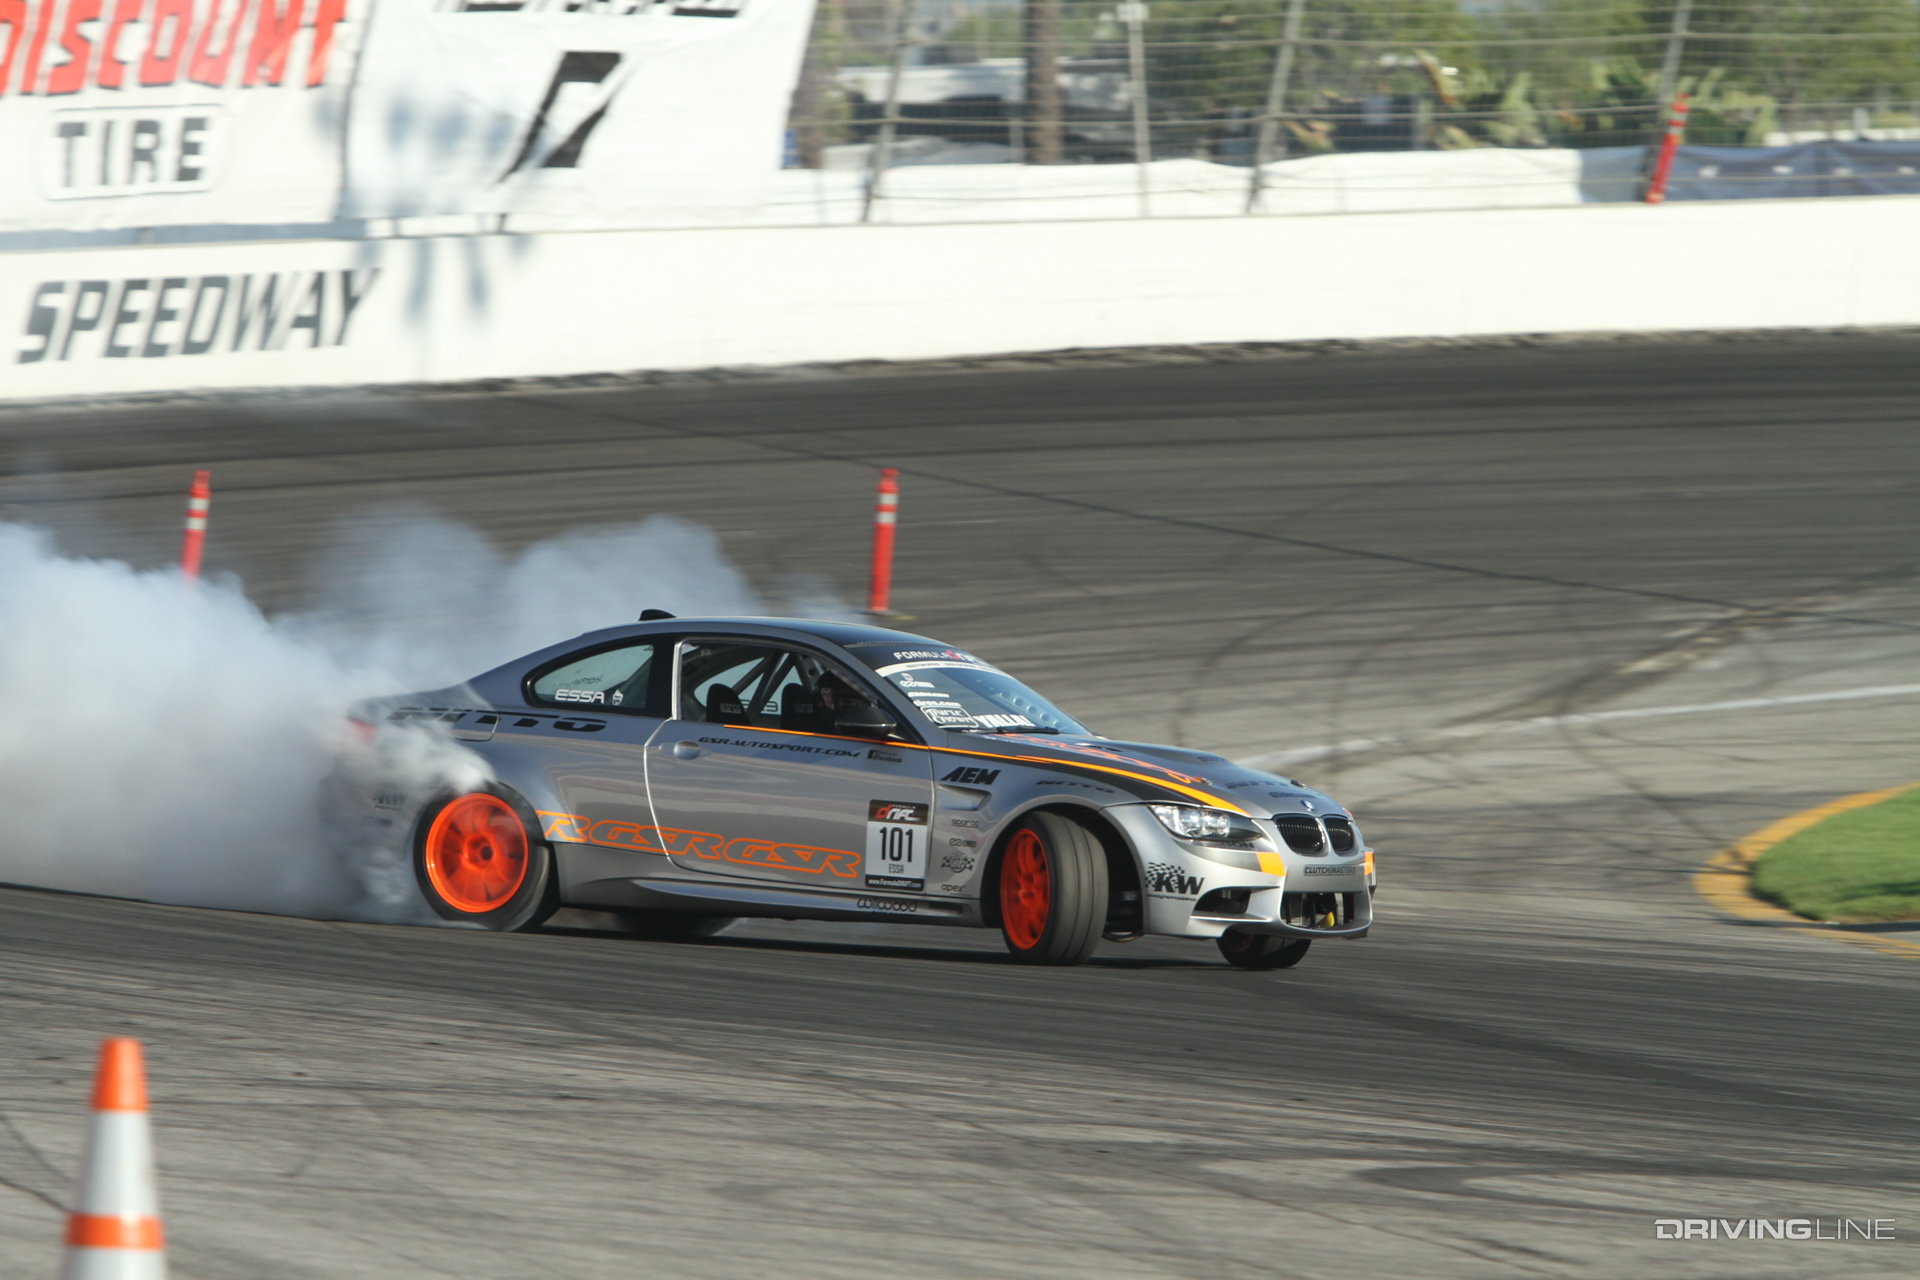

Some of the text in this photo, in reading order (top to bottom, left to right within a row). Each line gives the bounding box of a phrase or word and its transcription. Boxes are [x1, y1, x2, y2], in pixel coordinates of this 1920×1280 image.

[56, 116, 209, 188] TIRE
[15, 267, 384, 365] SPEEDWAY
[893, 650, 950, 660] FORMULA
[554, 688, 605, 704] ESSA
[386, 707, 608, 732] NITTO
[941, 766, 1002, 786] AEM
[879, 826, 914, 863] 101
[888, 863, 905, 874] ESSA
[1305, 866, 1330, 874] CLUTCH
[1153, 872, 1206, 896] KW
